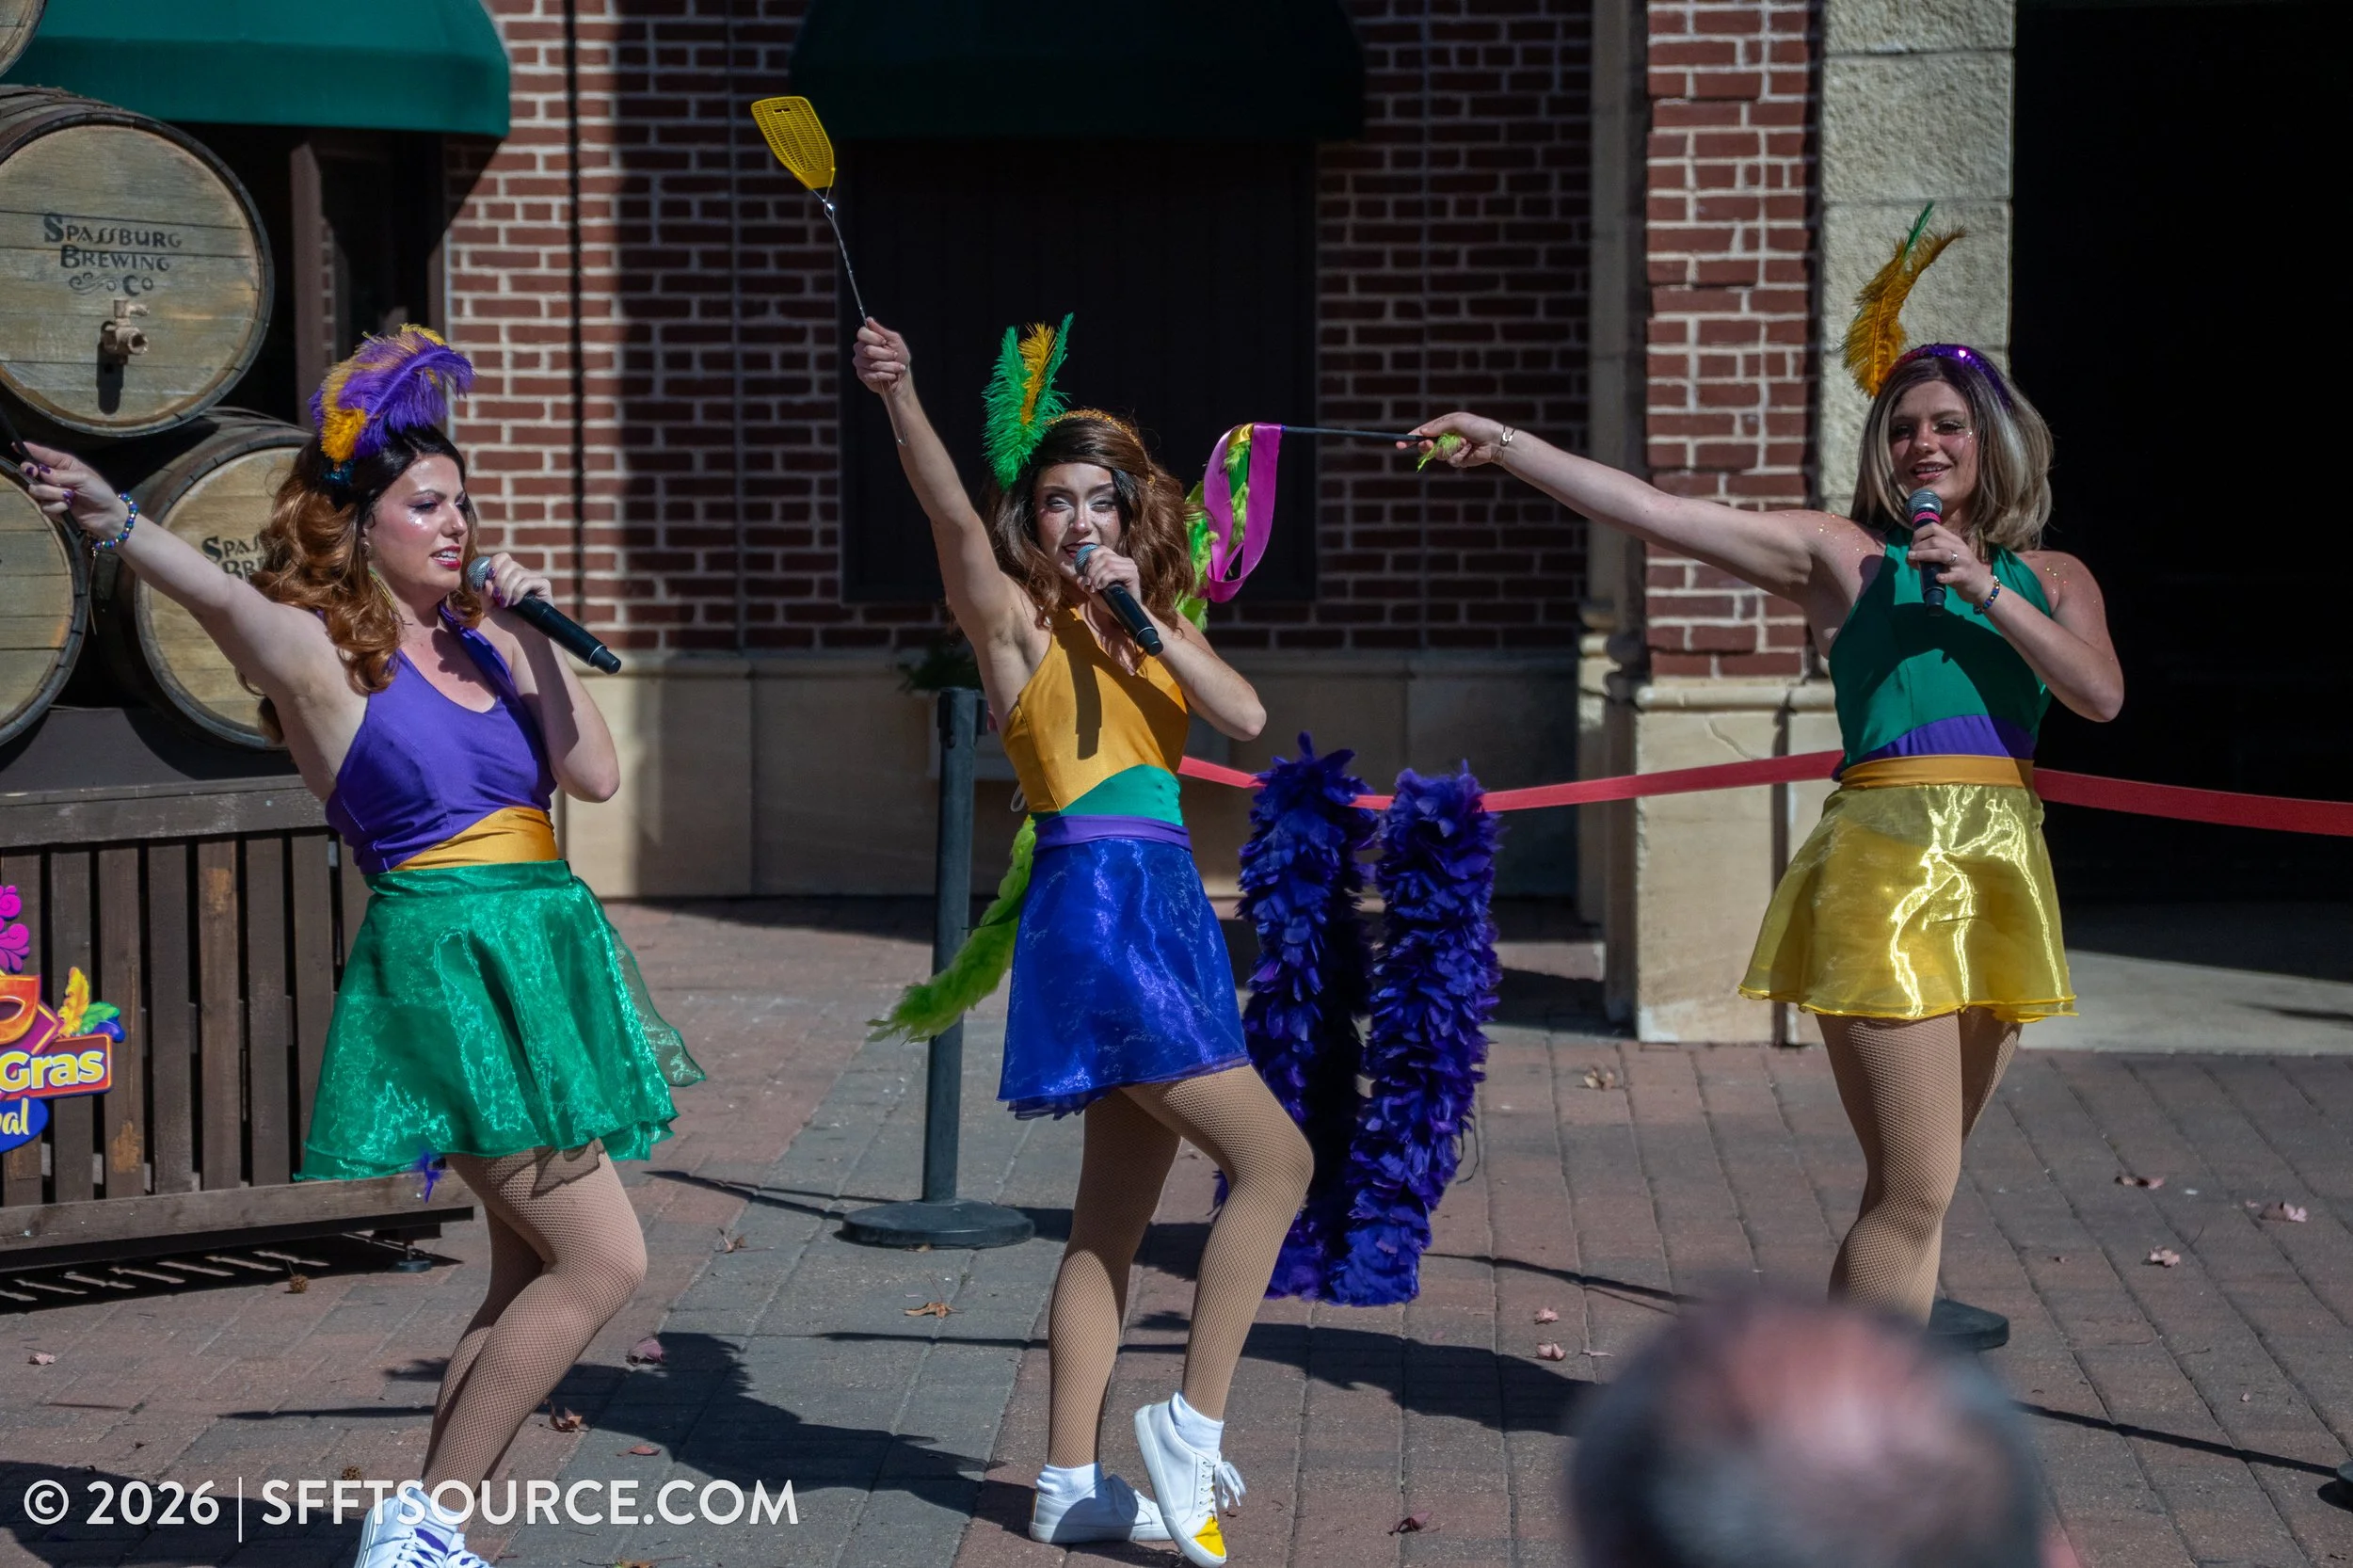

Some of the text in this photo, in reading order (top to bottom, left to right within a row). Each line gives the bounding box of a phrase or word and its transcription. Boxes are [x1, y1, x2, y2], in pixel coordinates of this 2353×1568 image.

[43, 213, 183, 248] SPASSBURG
[60, 245, 169, 272] BREWING
[0, 1050, 104, 1092] Gras
